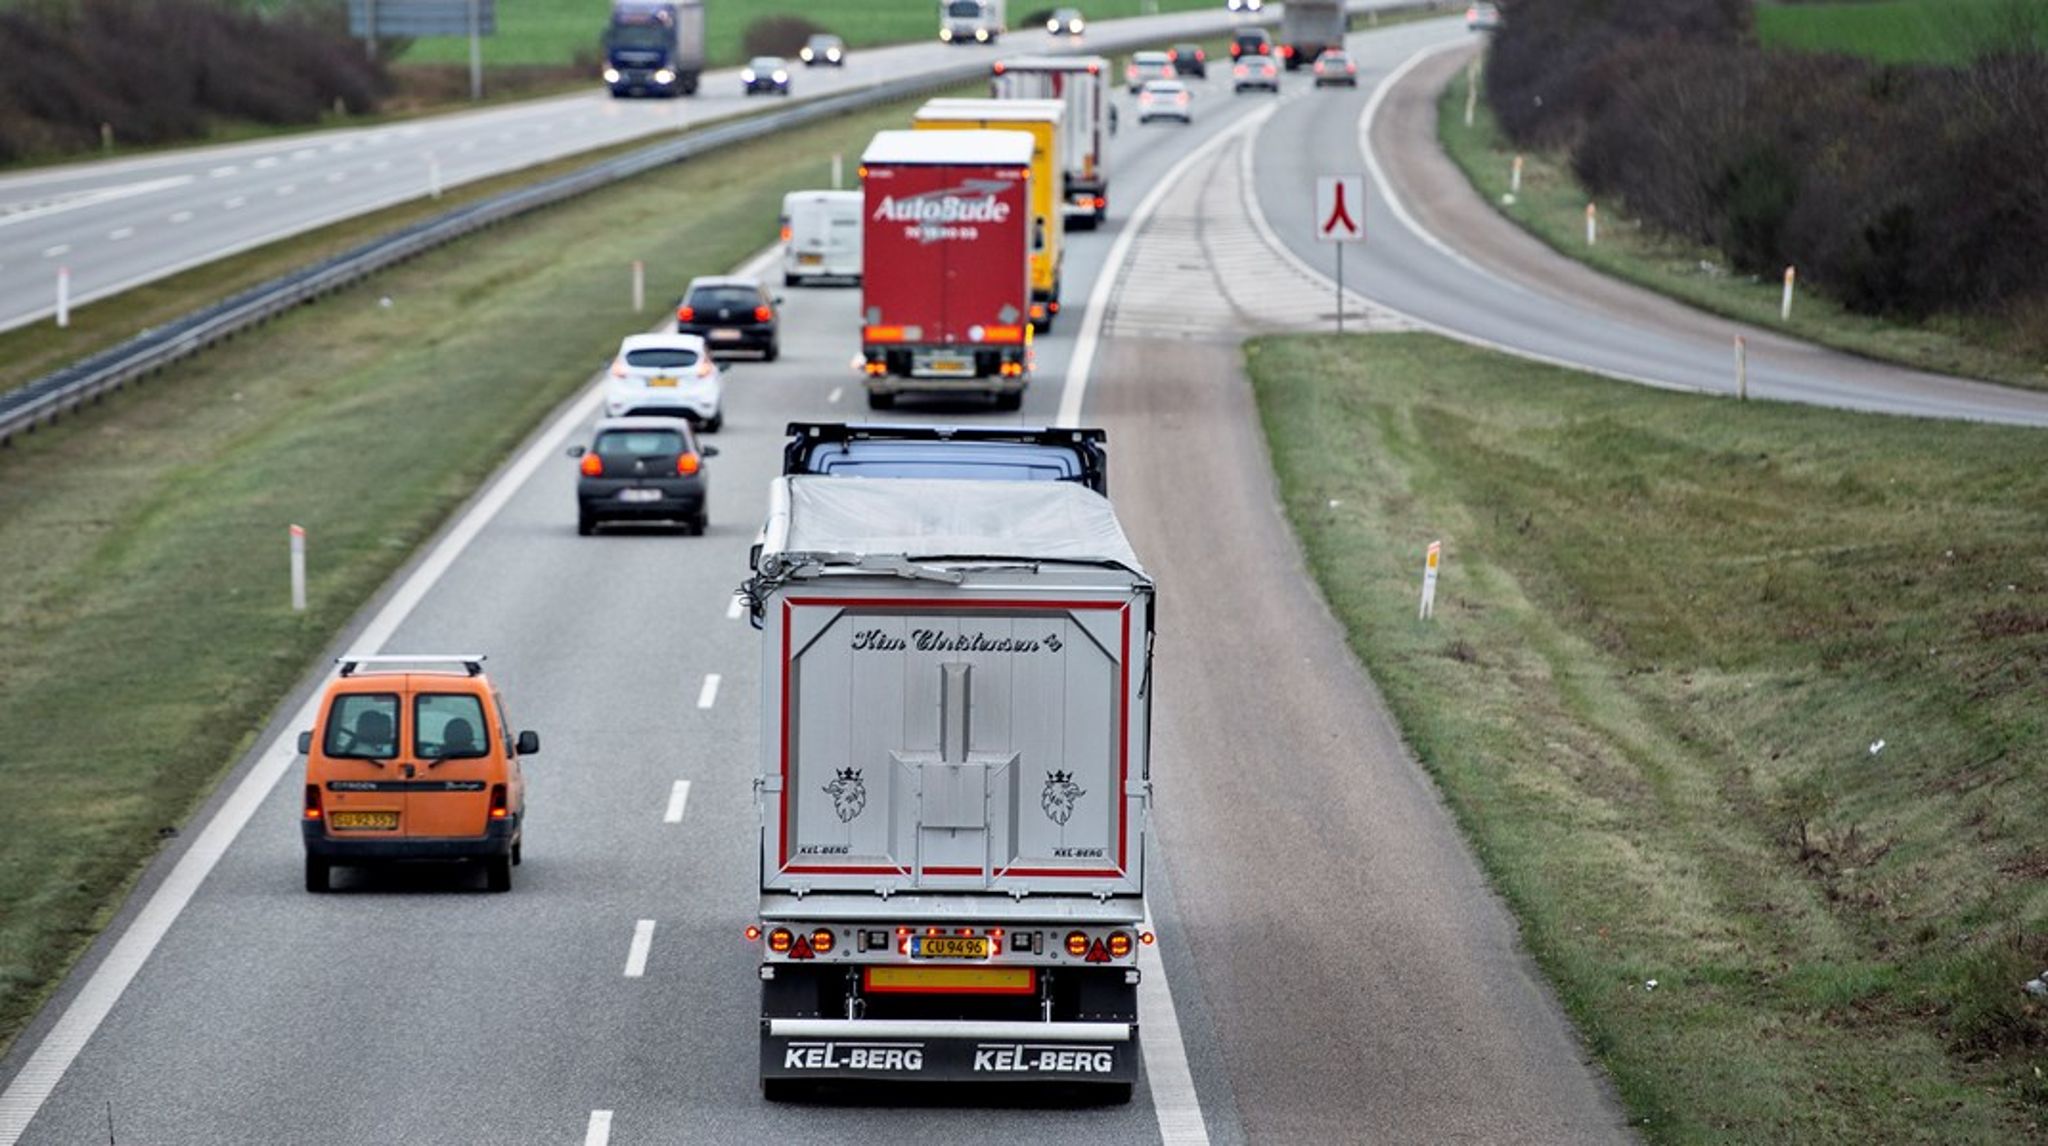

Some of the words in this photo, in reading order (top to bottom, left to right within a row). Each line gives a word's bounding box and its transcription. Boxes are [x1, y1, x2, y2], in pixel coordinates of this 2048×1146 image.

[873, 194, 1010, 222] AutoBude
[852, 629, 906, 651] Kim
[911, 629, 1040, 652] Christensen
[800, 845, 848, 854] KEL-BERG
[1054, 847, 1103, 858] KEL-BERG
[927, 940, 944, 953] CU
[784, 1044, 924, 1071] KEL-BERG
[974, 1044, 1113, 1072] KEL-BERG
